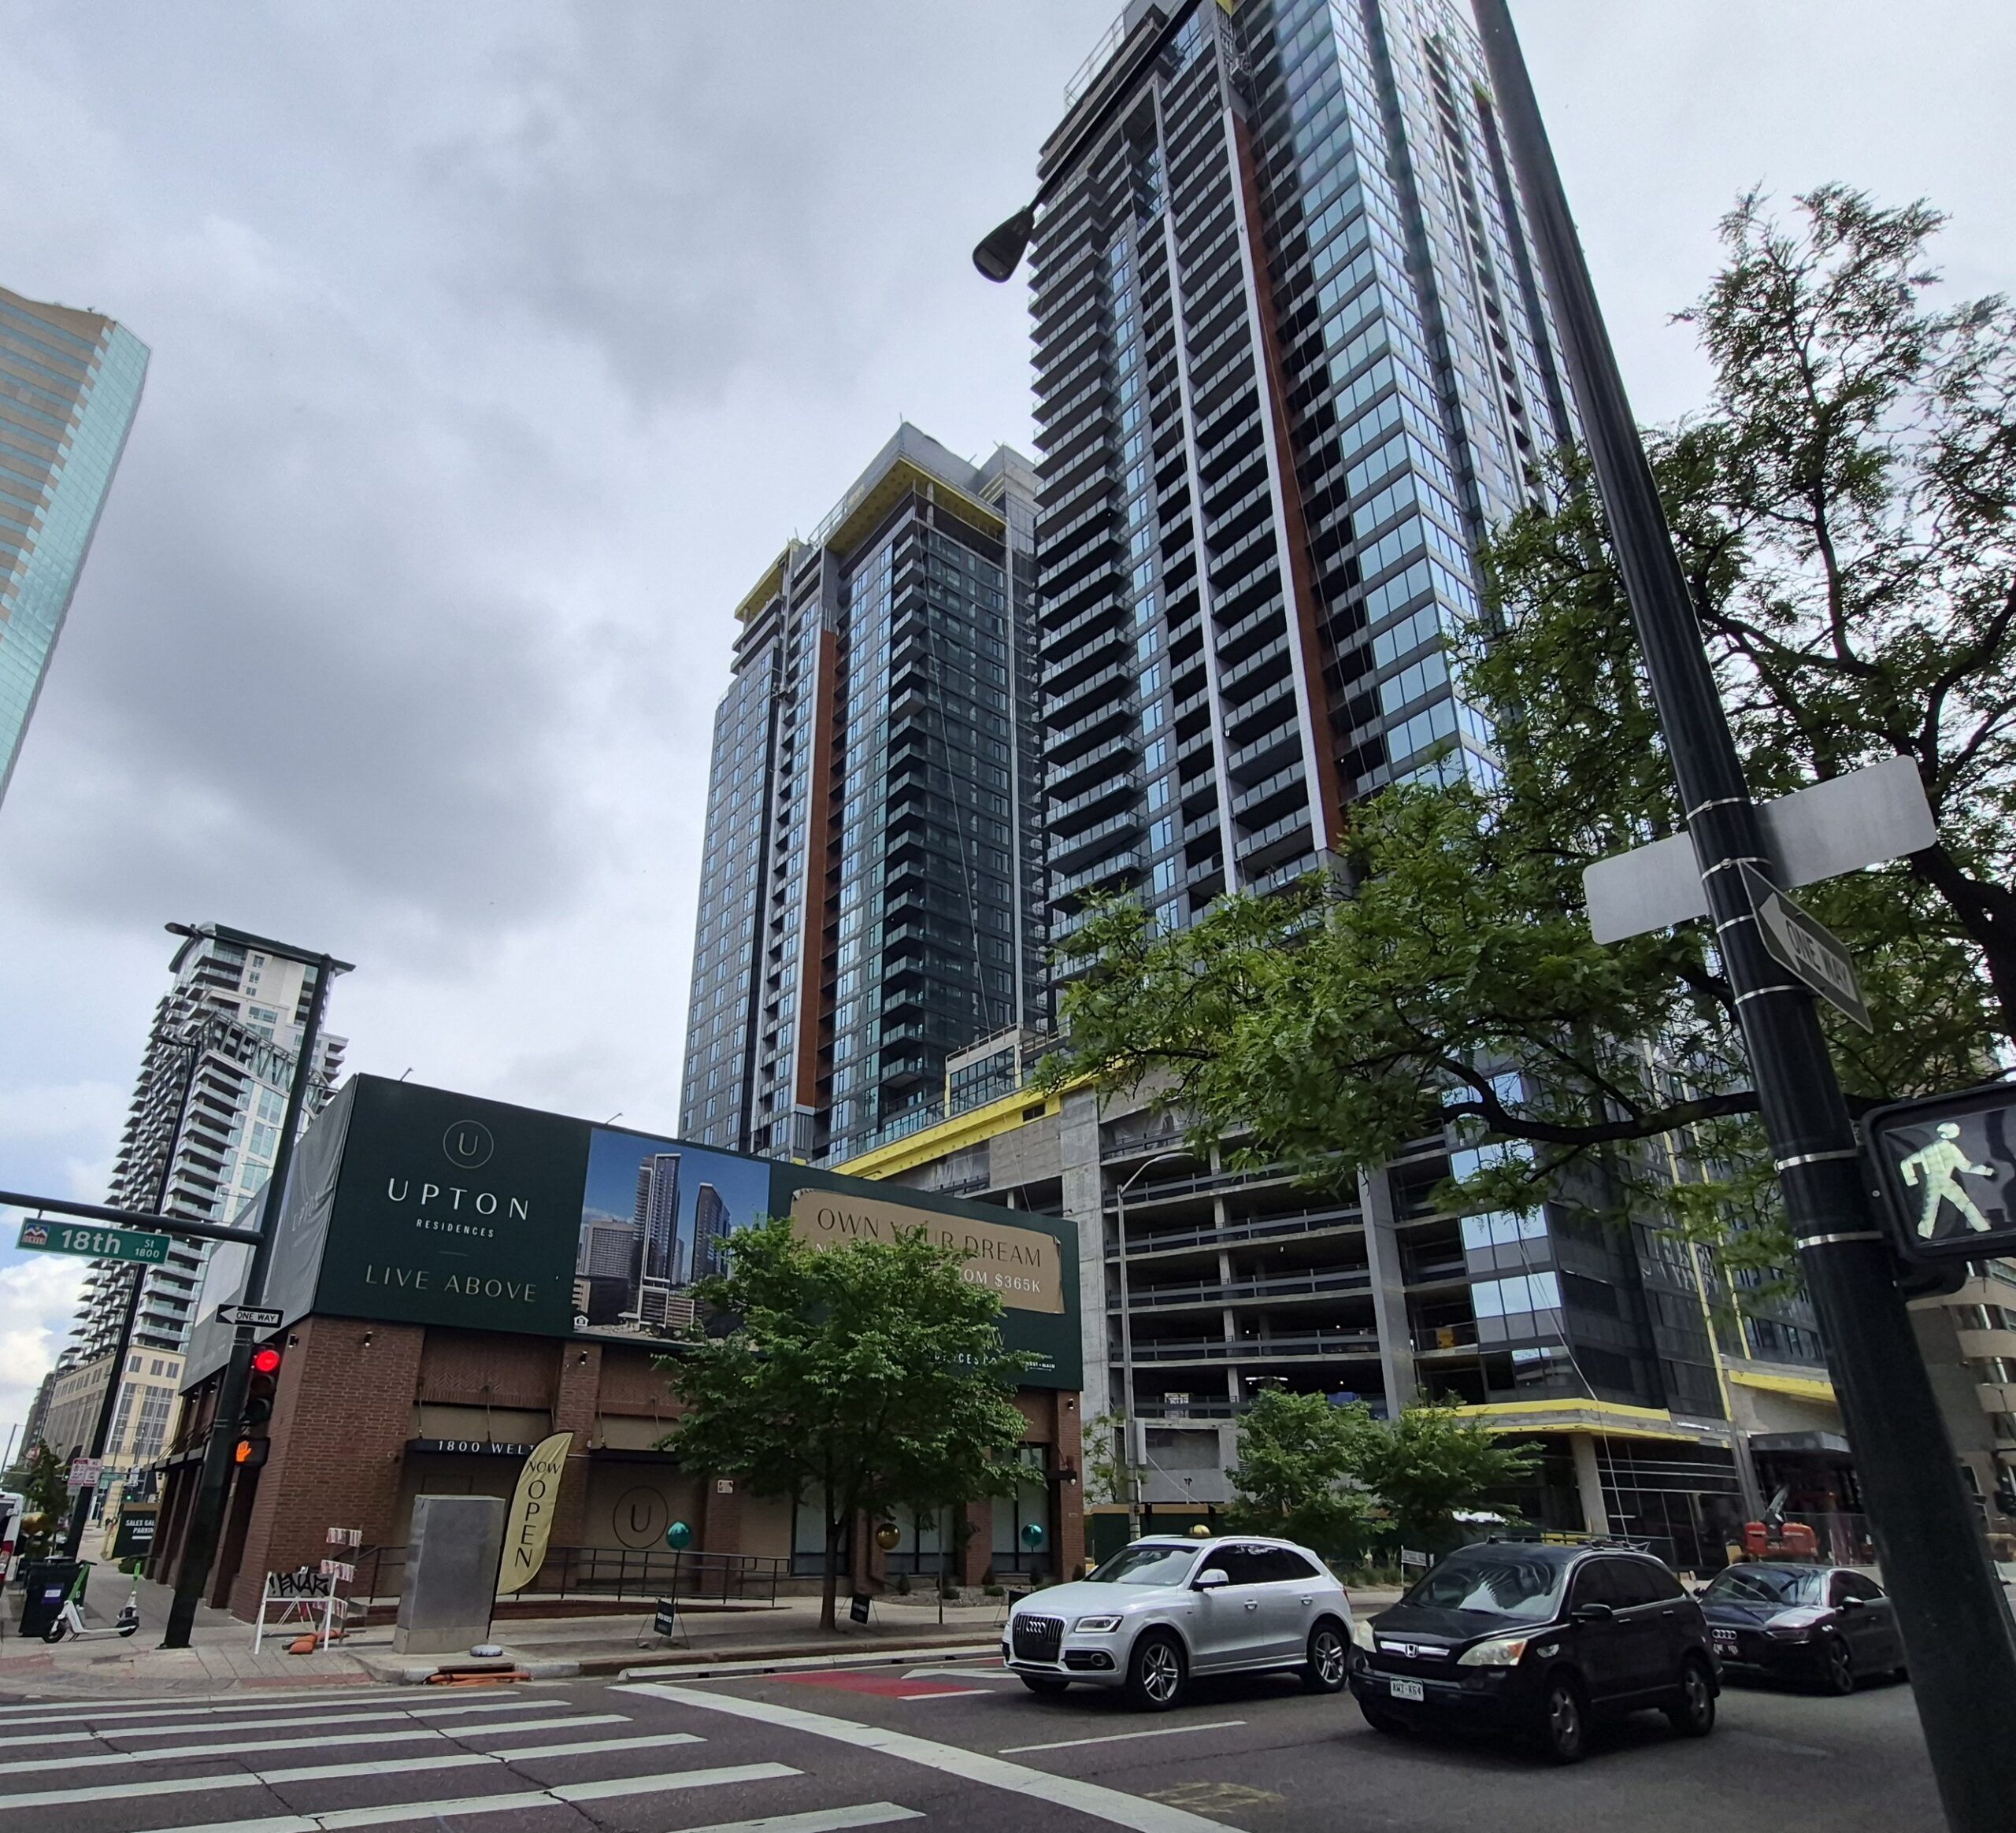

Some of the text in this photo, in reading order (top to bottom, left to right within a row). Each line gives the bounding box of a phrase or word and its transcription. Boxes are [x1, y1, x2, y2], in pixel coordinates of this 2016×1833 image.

[1785, 920, 1851, 996] ONE WAY
[458, 1131, 479, 1157] U
[387, 1177, 528, 1220] UPTON
[416, 1218, 494, 1238] RESIDENCES
[817, 1207, 879, 1238] OWN
[965, 1235, 1040, 1268] DREAM
[61, 1229, 121, 1254] 18th
[143, 1239, 155, 1248] St
[135, 1247, 160, 1258] 1800
[366, 1264, 537, 1302] LIVE ABOVE
[995, 1272, 1040, 1294] $365K
[236, 1311, 276, 1322] ONE WAY
[438, 1440, 480, 1453] 1800
[526, 1461, 561, 1475] NOW
[514, 1479, 547, 1568] OPEN
[631, 1504, 652, 1533] U
